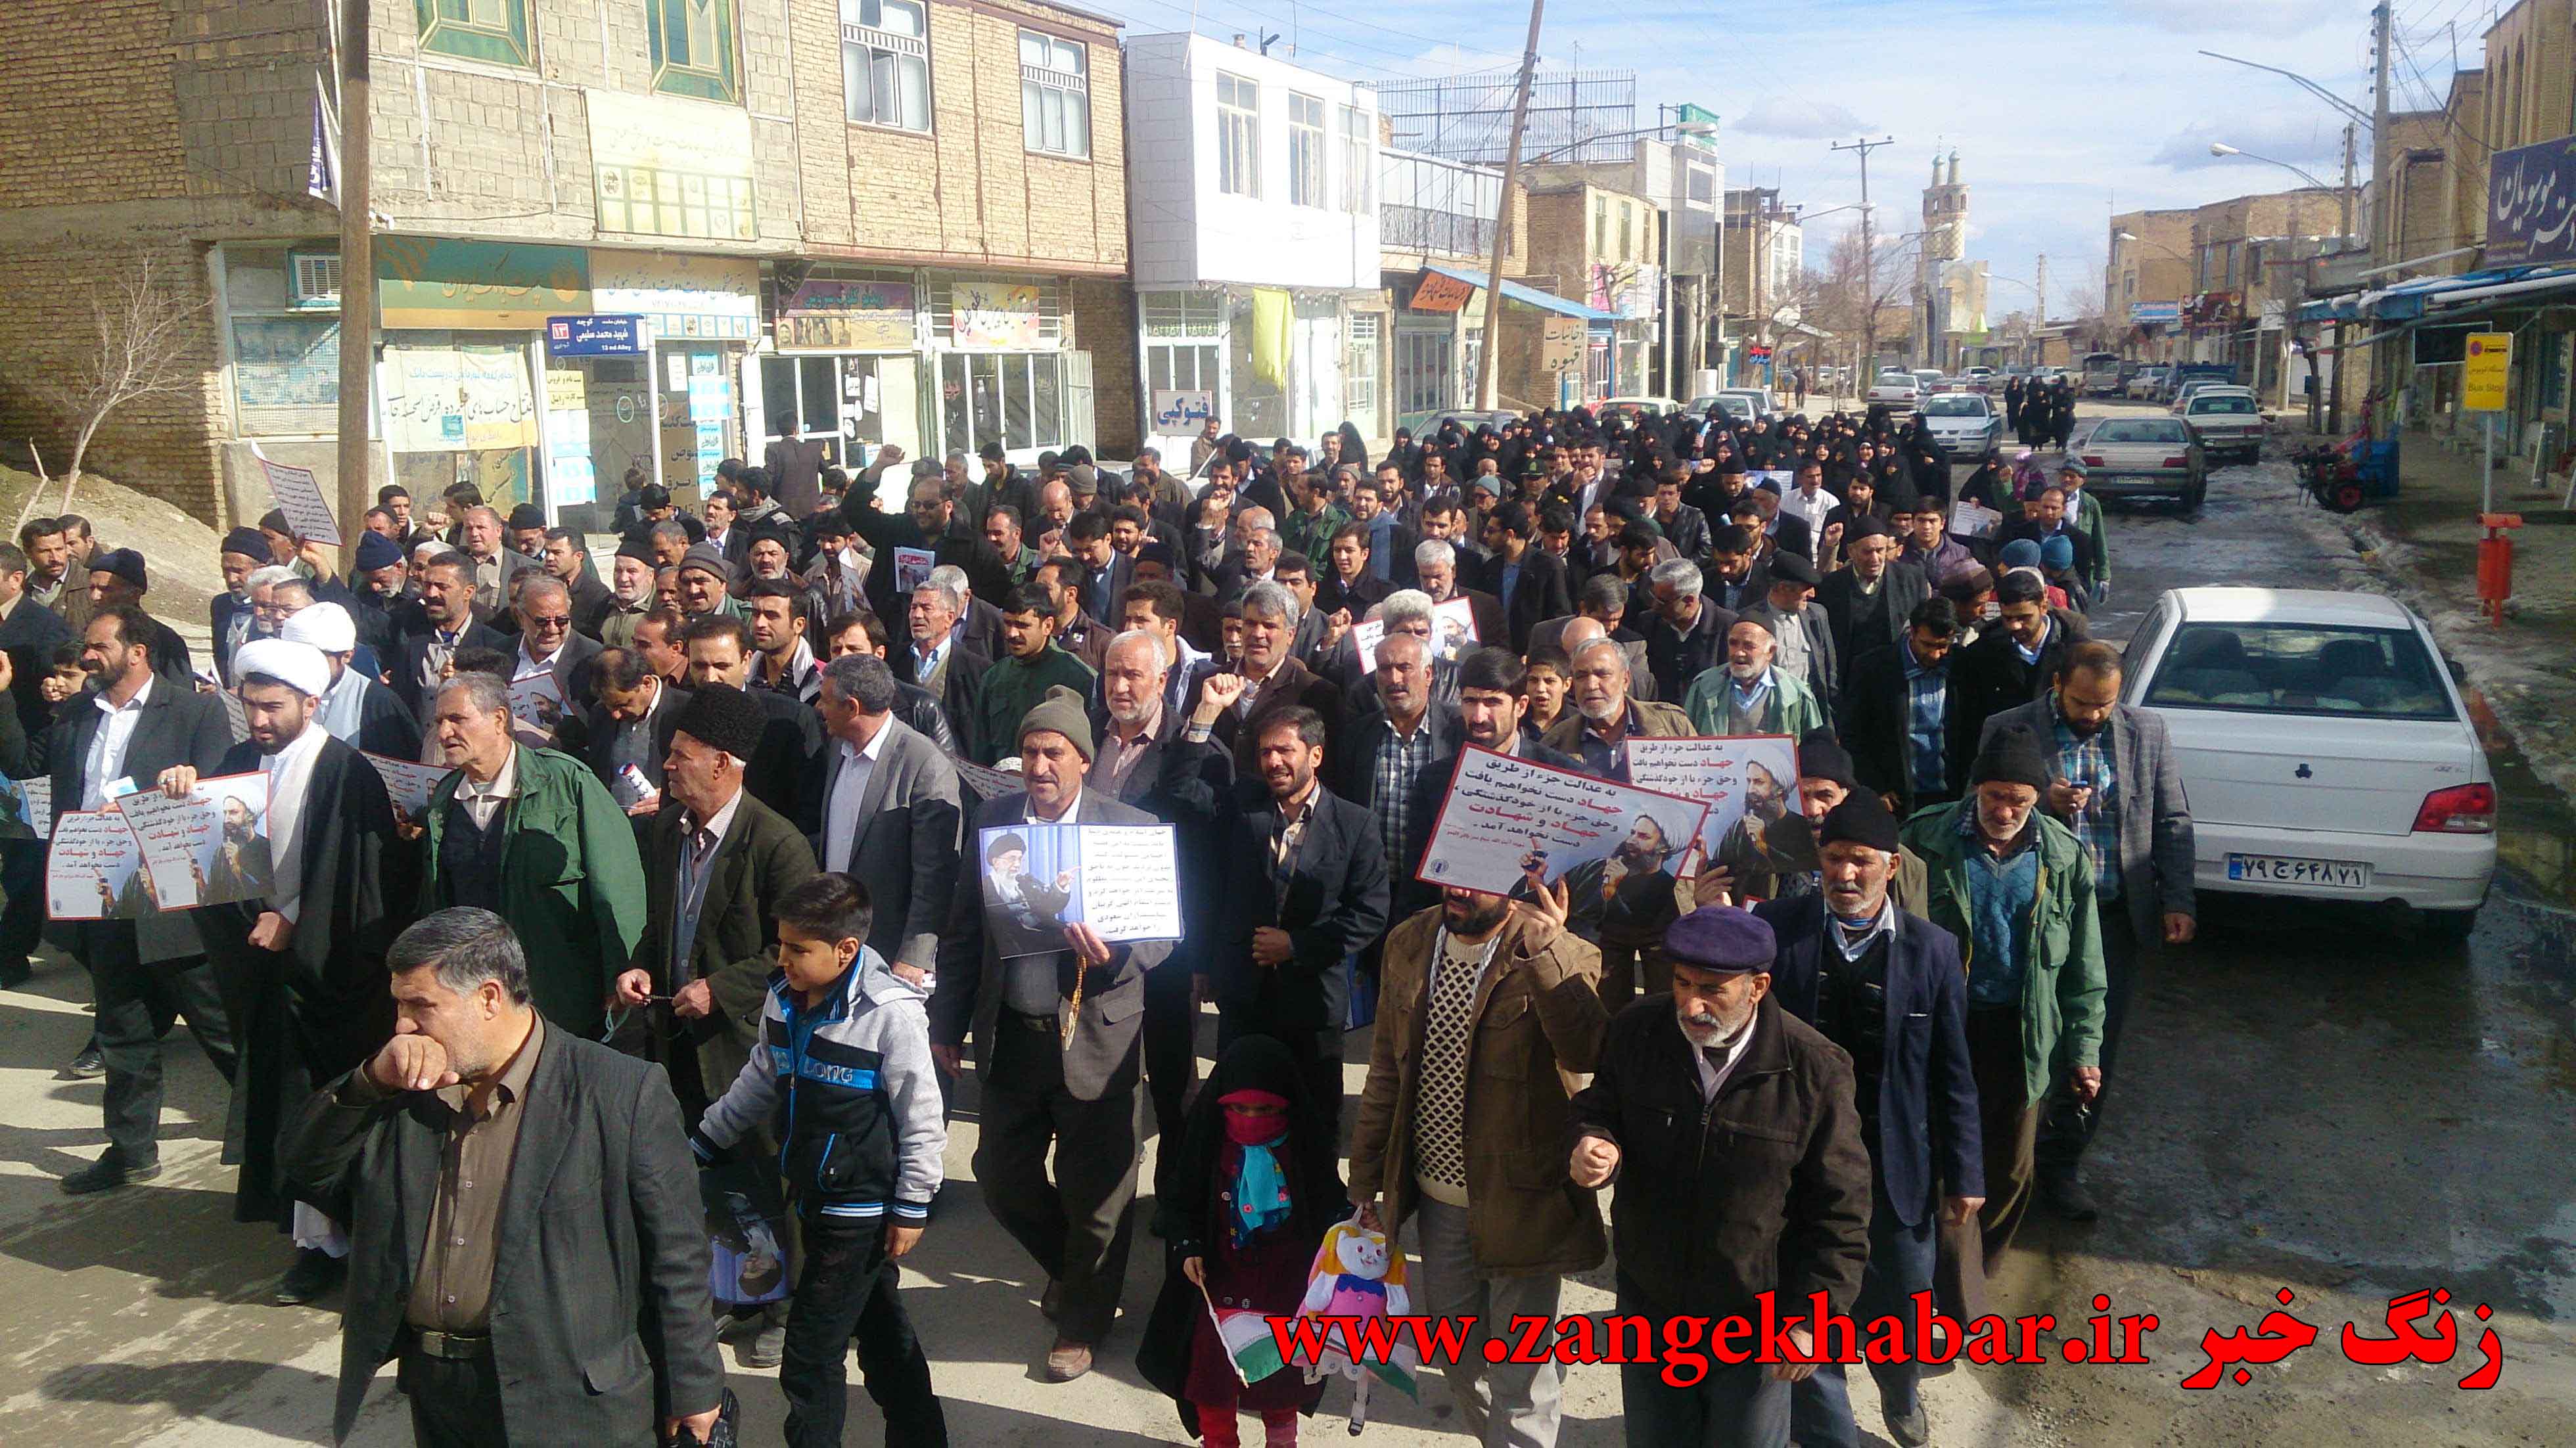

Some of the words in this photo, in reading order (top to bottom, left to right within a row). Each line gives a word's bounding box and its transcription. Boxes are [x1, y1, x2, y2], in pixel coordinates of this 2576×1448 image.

[554, 325, 568, 338] ۱۳
[614, 328, 628, 340] شهید
[1550, 345, 1581, 371] قهوه
[1157, 396, 1208, 427] فتوکپی
[1640, 743, 1659, 754] طریق
[1686, 743, 1711, 752] عدالت
[1486, 759, 1519, 773] طریق
[1649, 759, 1676, 770] نخواهیم
[1700, 757, 1734, 769] جهاد
[1465, 769, 1492, 784] یافت
[1522, 769, 1535, 779] از
[1495, 781, 1542, 796] نخواهیم
[1564, 779, 1601, 793] عدالت
[1545, 793, 1575, 803] دست
[1693, 788, 1728, 800] جهاد
[189, 796, 212, 806] جهاد
[1577, 796, 1623, 817] جهاد
[1469, 803, 1535, 823] شهادت
[187, 823, 210, 833] جهاد
[1507, 826, 1549, 840] نخواهد
[1550, 819, 1600, 840] جهاد
[1552, 836, 1580, 848] دست
[99, 849, 126, 858] جهاد
[2243, 858, 2267, 878] ۷۹
[2294, 862, 2333, 882] ۶۴۸
[2338, 868, 2361, 886] ۷۱
